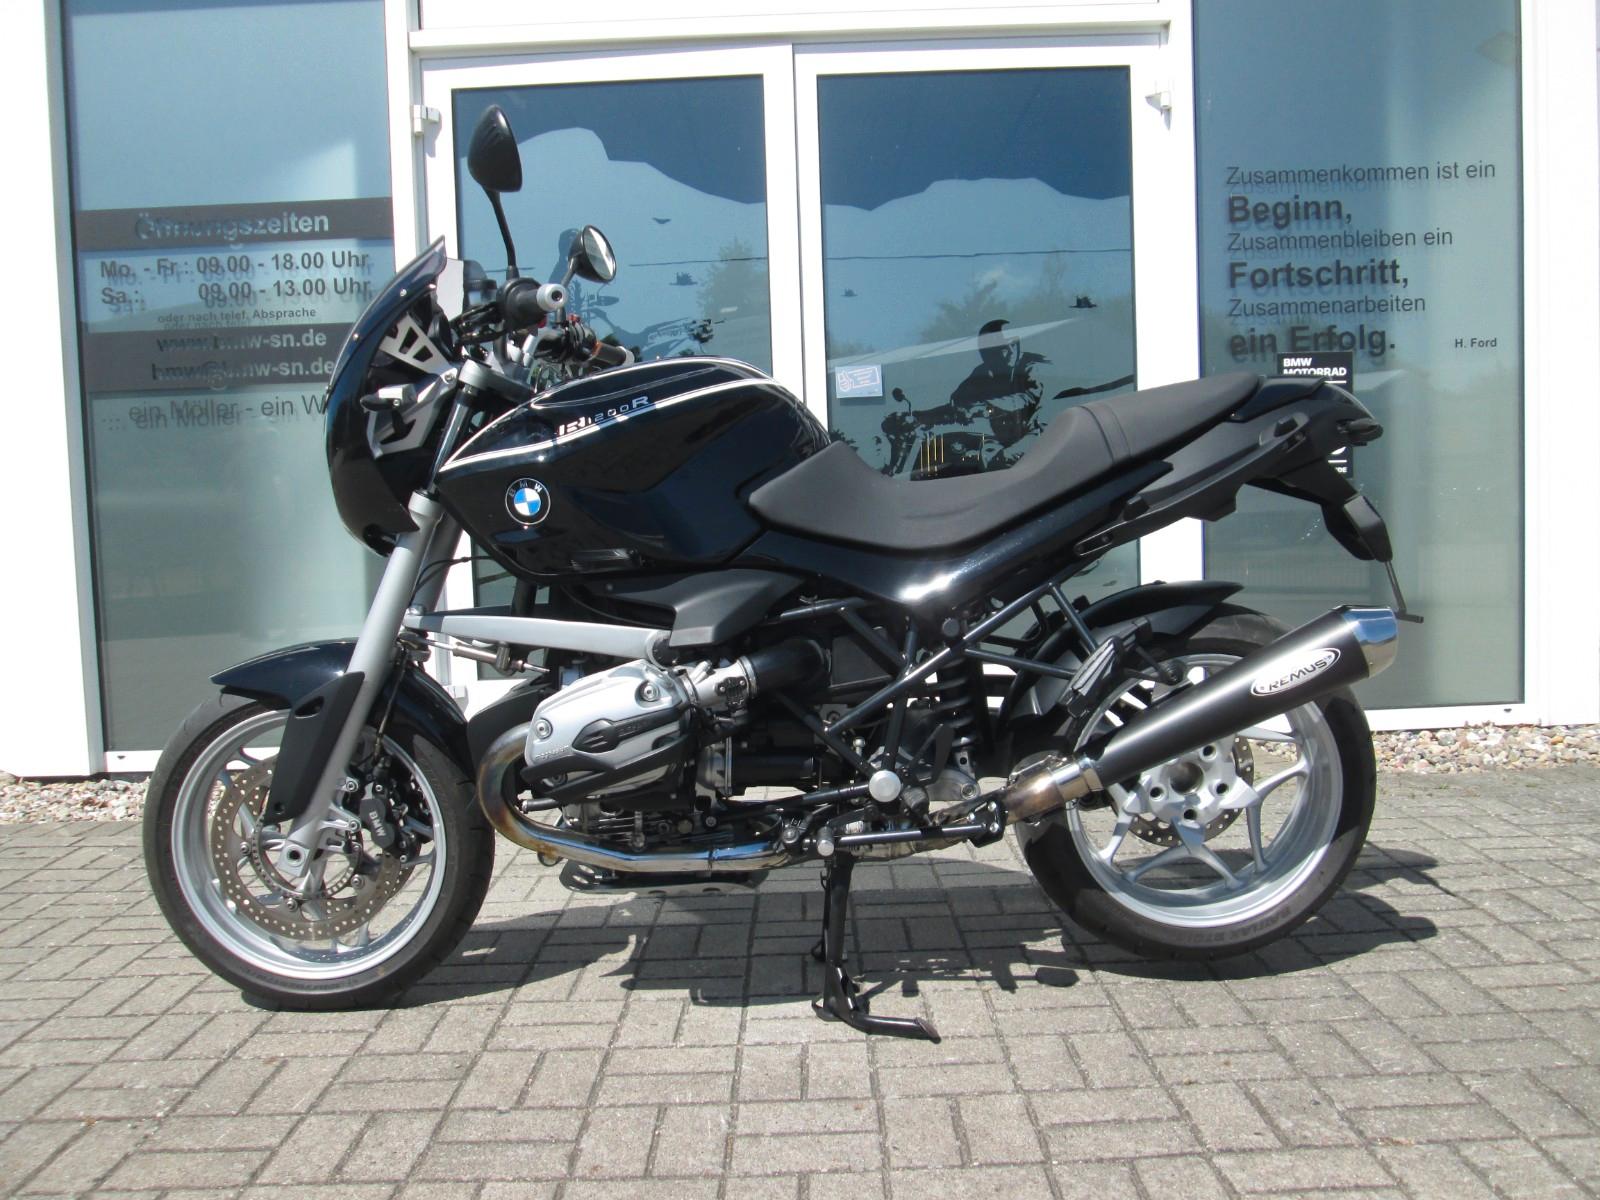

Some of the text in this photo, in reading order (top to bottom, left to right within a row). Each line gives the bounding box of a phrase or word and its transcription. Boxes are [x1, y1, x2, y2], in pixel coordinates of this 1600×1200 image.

[1226, 160, 1496, 185] Zusammenkommen ist ein
[1228, 194, 1352, 229] Beginn,
[1227, 228, 1453, 251] Zusammenbleiben ein
[197, 255, 250, 274] 09.00
[272, 252, 324, 270] 18.00
[332, 250, 369, 269] Uhr
[1229, 258, 1408, 288] Fortschritt,
[198, 281, 252, 300] 09.00
[273, 278, 326, 297] 13.00
[333, 277, 371, 296] Uhr
[158, 312, 184, 323] oder
[188, 311, 217, 322] nach
[253, 307, 317, 320] Absprache
[1227, 295, 1426, 317] Zusammenarbeiten
[1229, 324, 1396, 356] ein Erfolg.
[1454, 338, 1497, 348] H. Ford
[1283, 358, 1312, 367] BMW
[1283, 367, 1347, 376] MOTORRAD
[129, 401, 161, 421] ein
[261, 396, 294, 416] ein
[509, 482, 542, 498] BMW
[1268, 659, 1328, 691] REMUS
[369, 811, 387, 837] BMW
